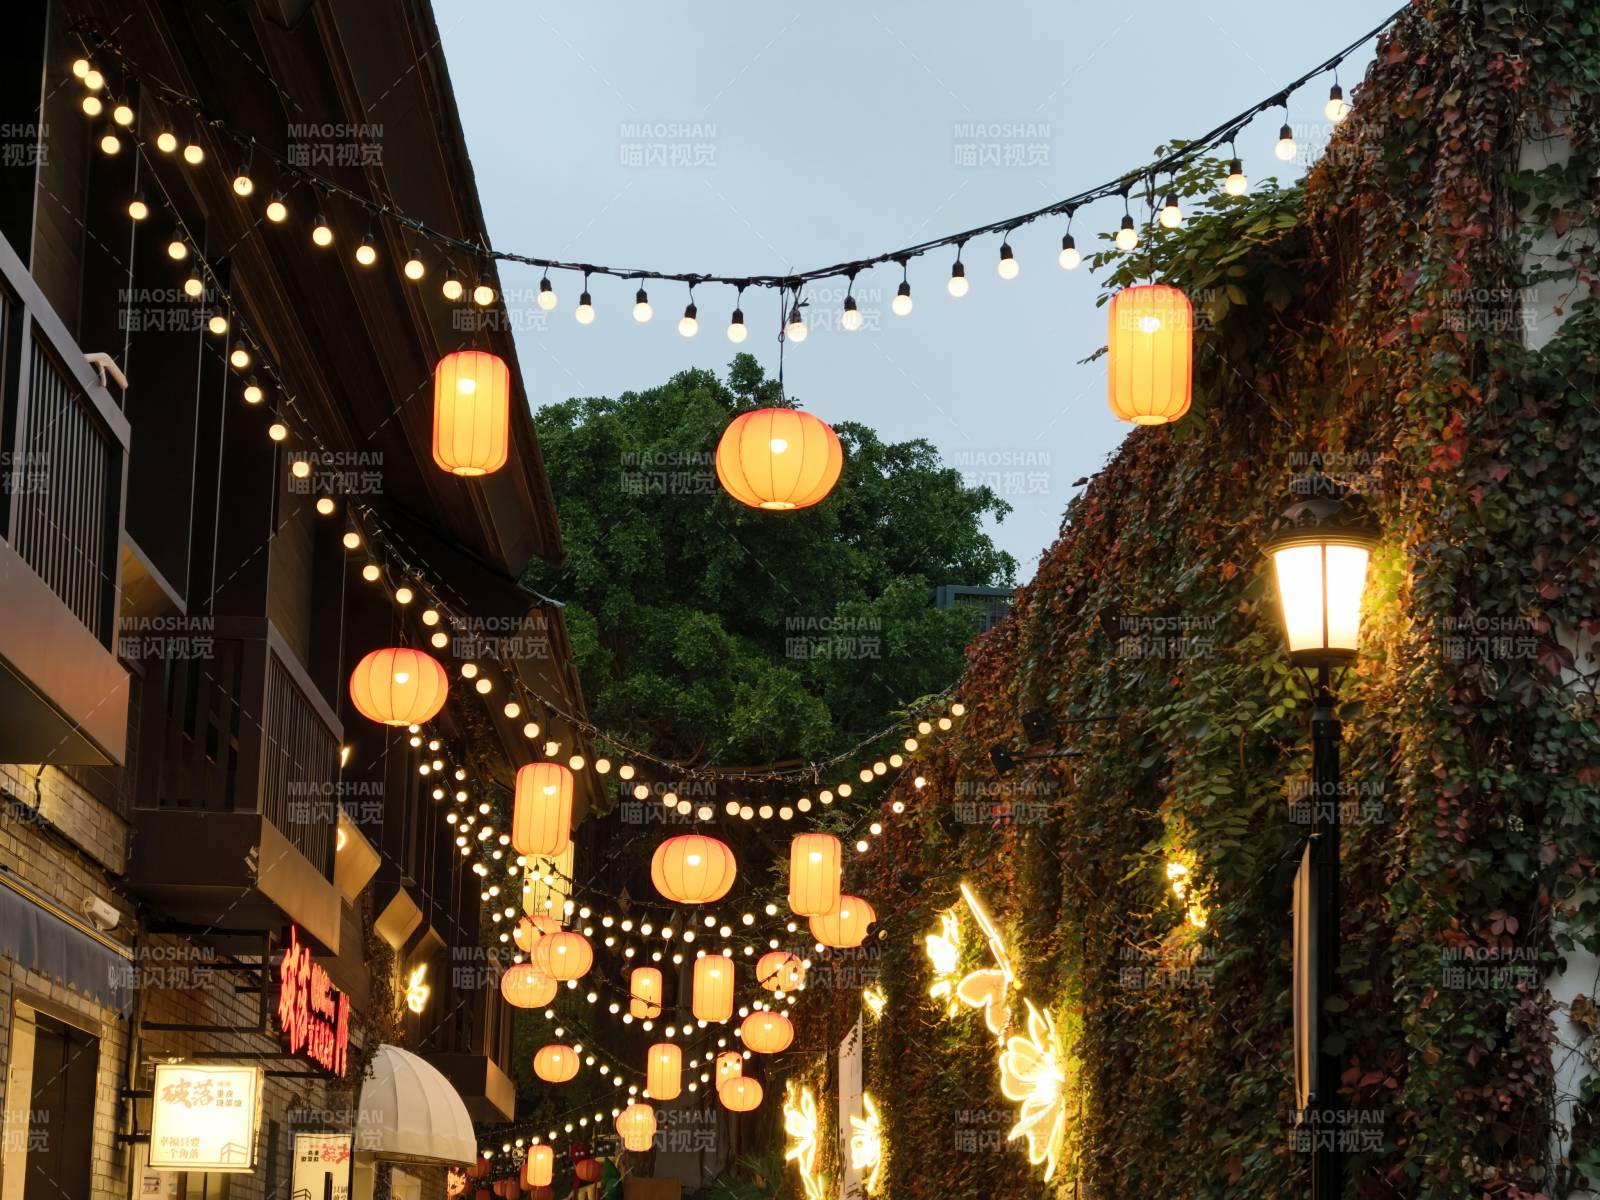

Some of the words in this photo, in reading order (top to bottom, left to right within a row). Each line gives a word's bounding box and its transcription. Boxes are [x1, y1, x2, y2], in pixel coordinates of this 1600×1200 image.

[160, 1077, 214, 1109] 破落
[160, 1135, 200, 1148] 幸福只要
